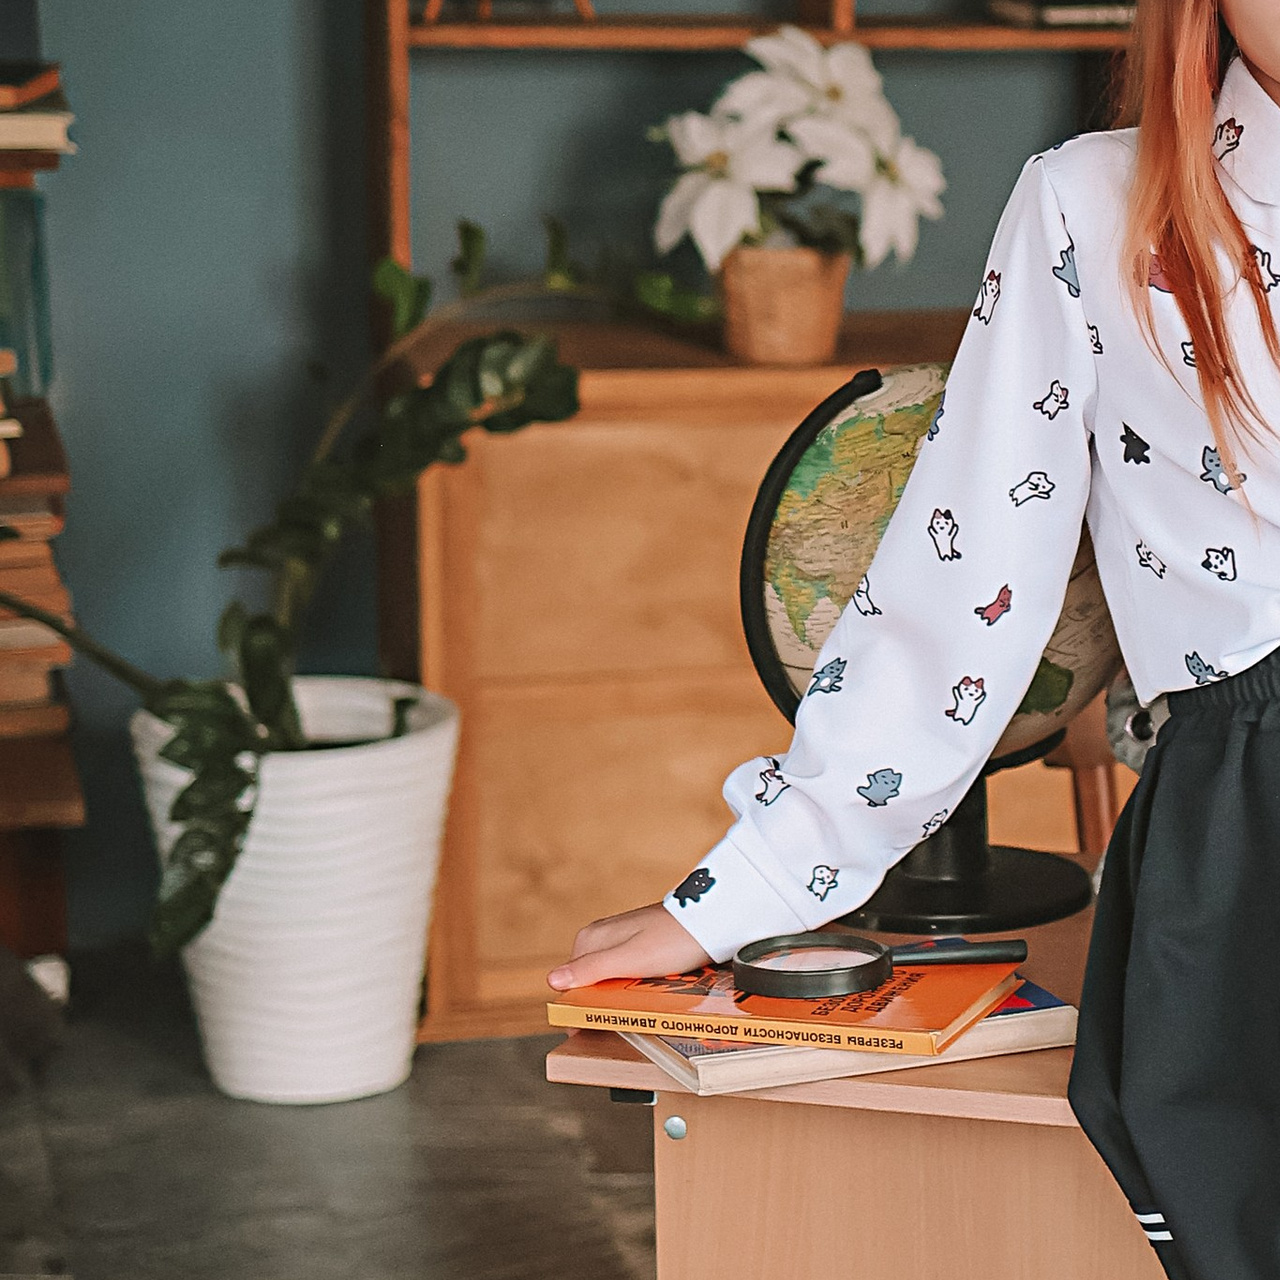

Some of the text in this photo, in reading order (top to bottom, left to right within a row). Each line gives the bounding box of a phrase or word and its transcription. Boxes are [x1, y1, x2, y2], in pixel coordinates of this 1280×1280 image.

[585, 1013, 903, 1049] РЕЗЕРВЫ БЕЗОПАСНОСТИ ДОРОЖНОГО ДВИЖЕНИЯ
